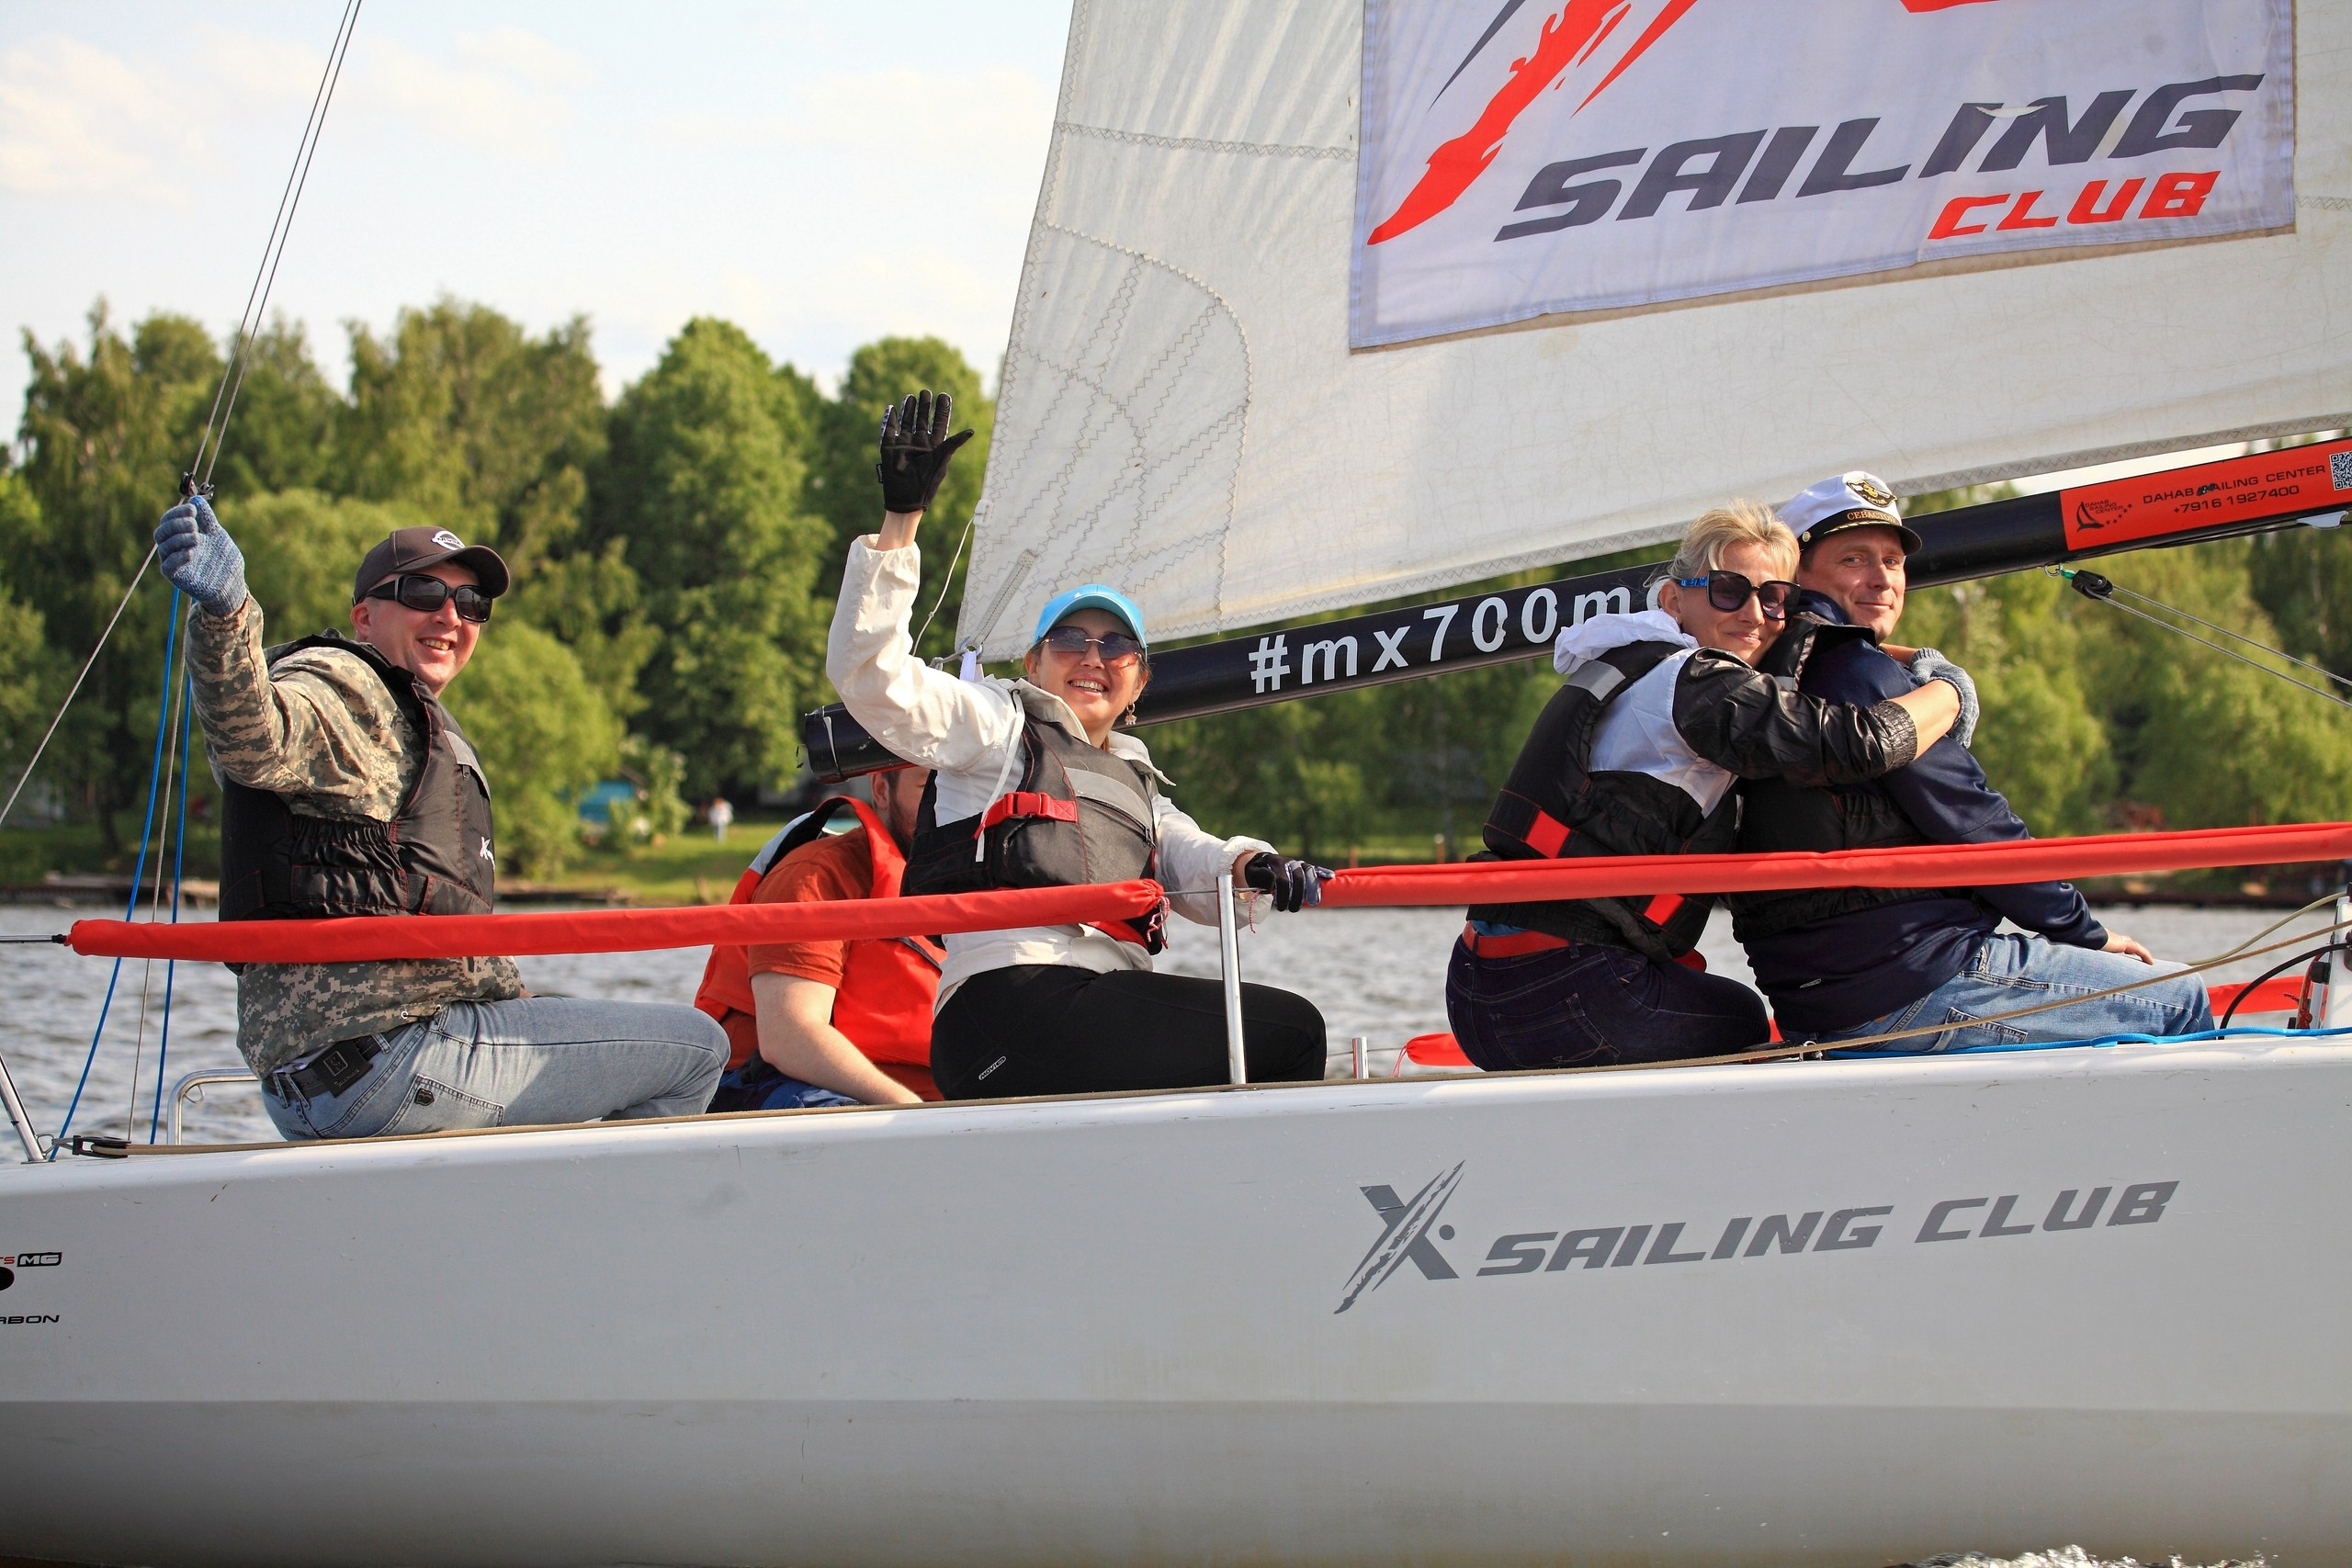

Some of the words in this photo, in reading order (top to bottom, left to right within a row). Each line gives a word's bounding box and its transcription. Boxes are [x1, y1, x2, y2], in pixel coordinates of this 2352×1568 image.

[1494, 73, 2266, 242] SAILING
[1929, 171, 2218, 239] CLUB
[2143, 488, 2194, 504] DAHAB
[2197, 477, 2259, 497] AILING
[2266, 465, 2325, 483] CENTER
[2174, 499, 2222, 513] +7916
[2226, 485, 2300, 504] 1927400
[2089, 502, 2117, 511] SAILING
[2095, 505, 2123, 513] CENTER
[1476, 1205, 1894, 1276] SAILING
[1915, 1181, 2179, 1243] CLUB
[18, 1254, 61, 1266] MG
